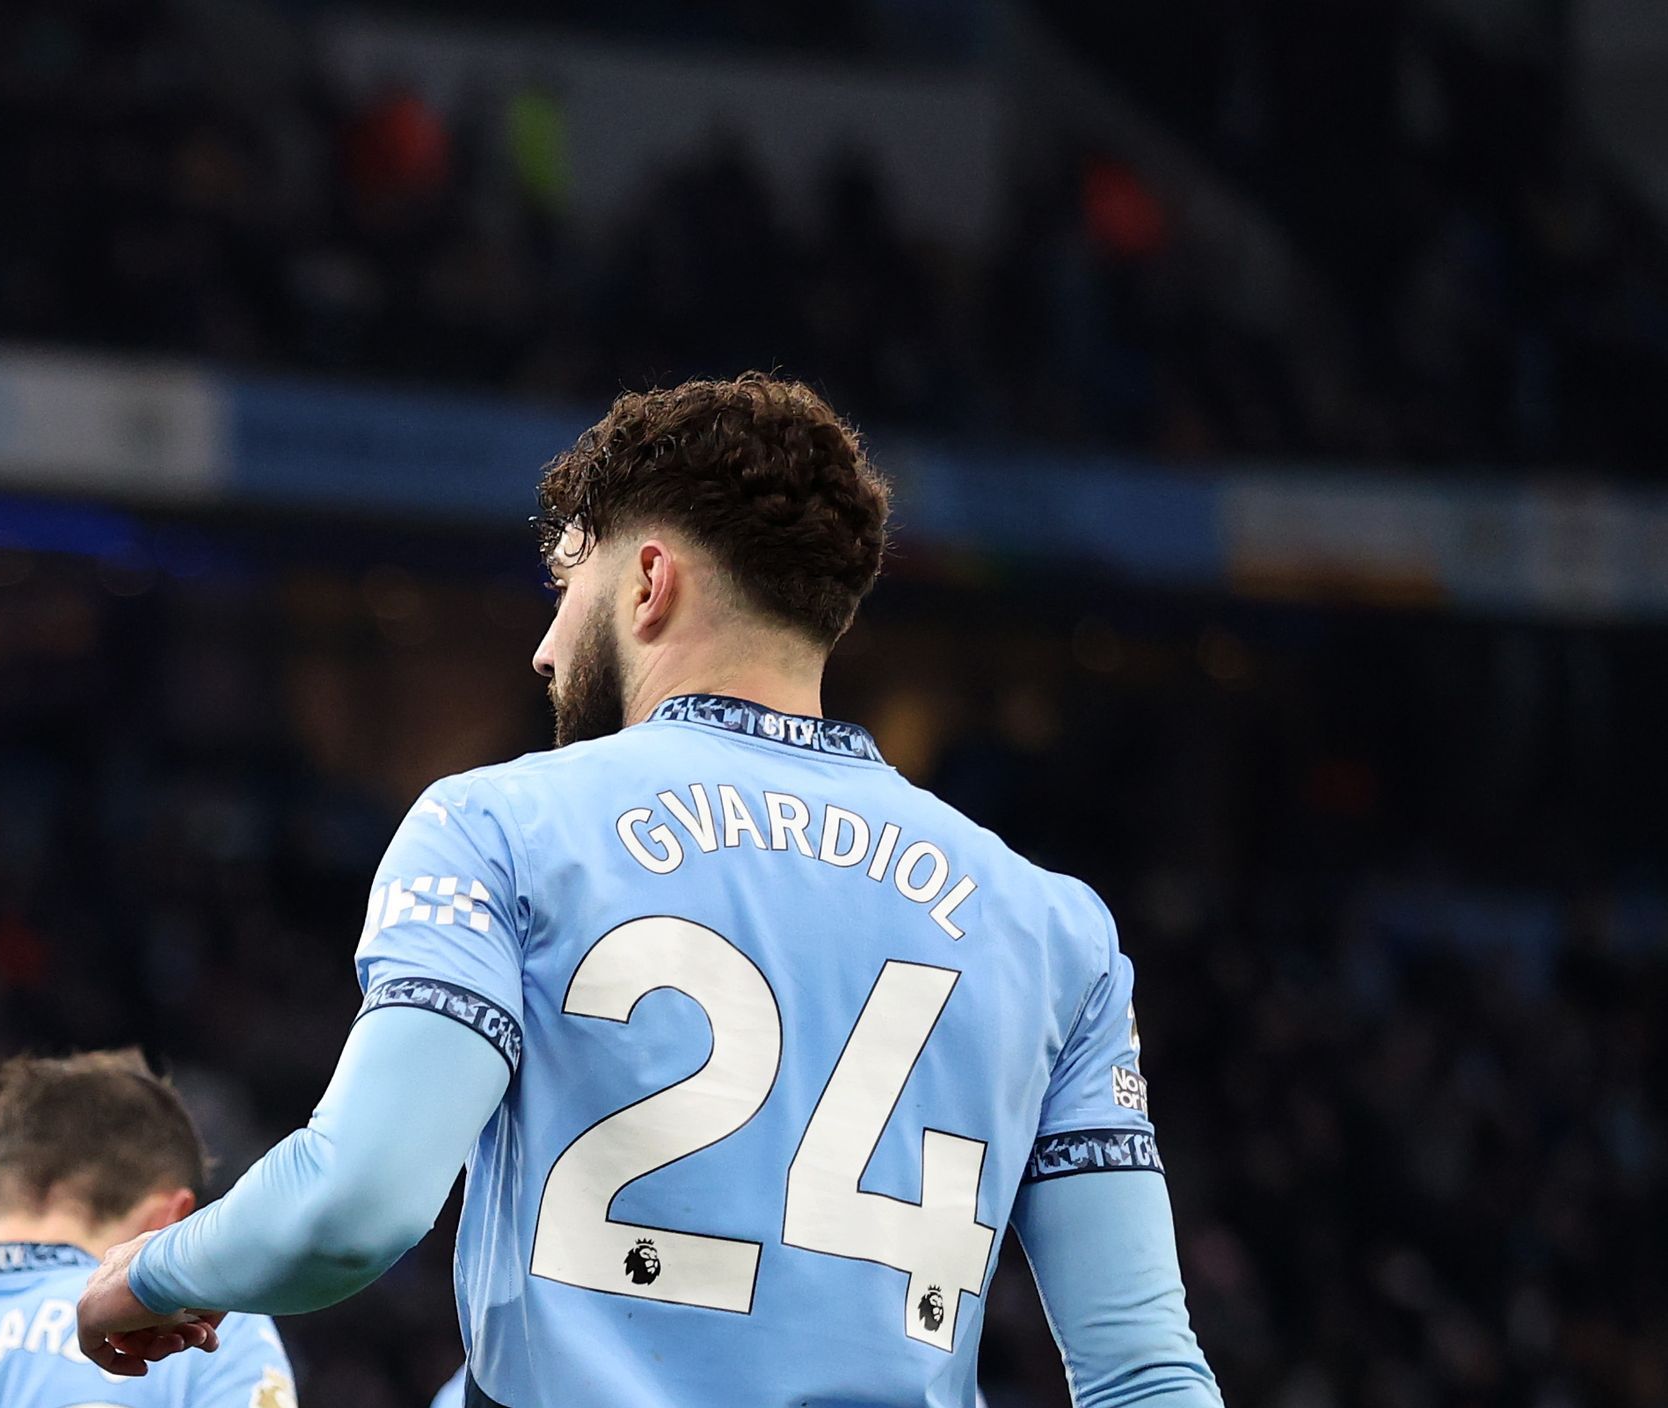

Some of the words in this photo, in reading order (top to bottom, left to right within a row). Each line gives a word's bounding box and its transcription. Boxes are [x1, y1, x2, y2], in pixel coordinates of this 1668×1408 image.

[764, 713, 815, 745] CITY
[616, 782, 978, 941] GVARDIOL
[1112, 1066, 1138, 1092] No
[530, 916, 996, 1353] 24
